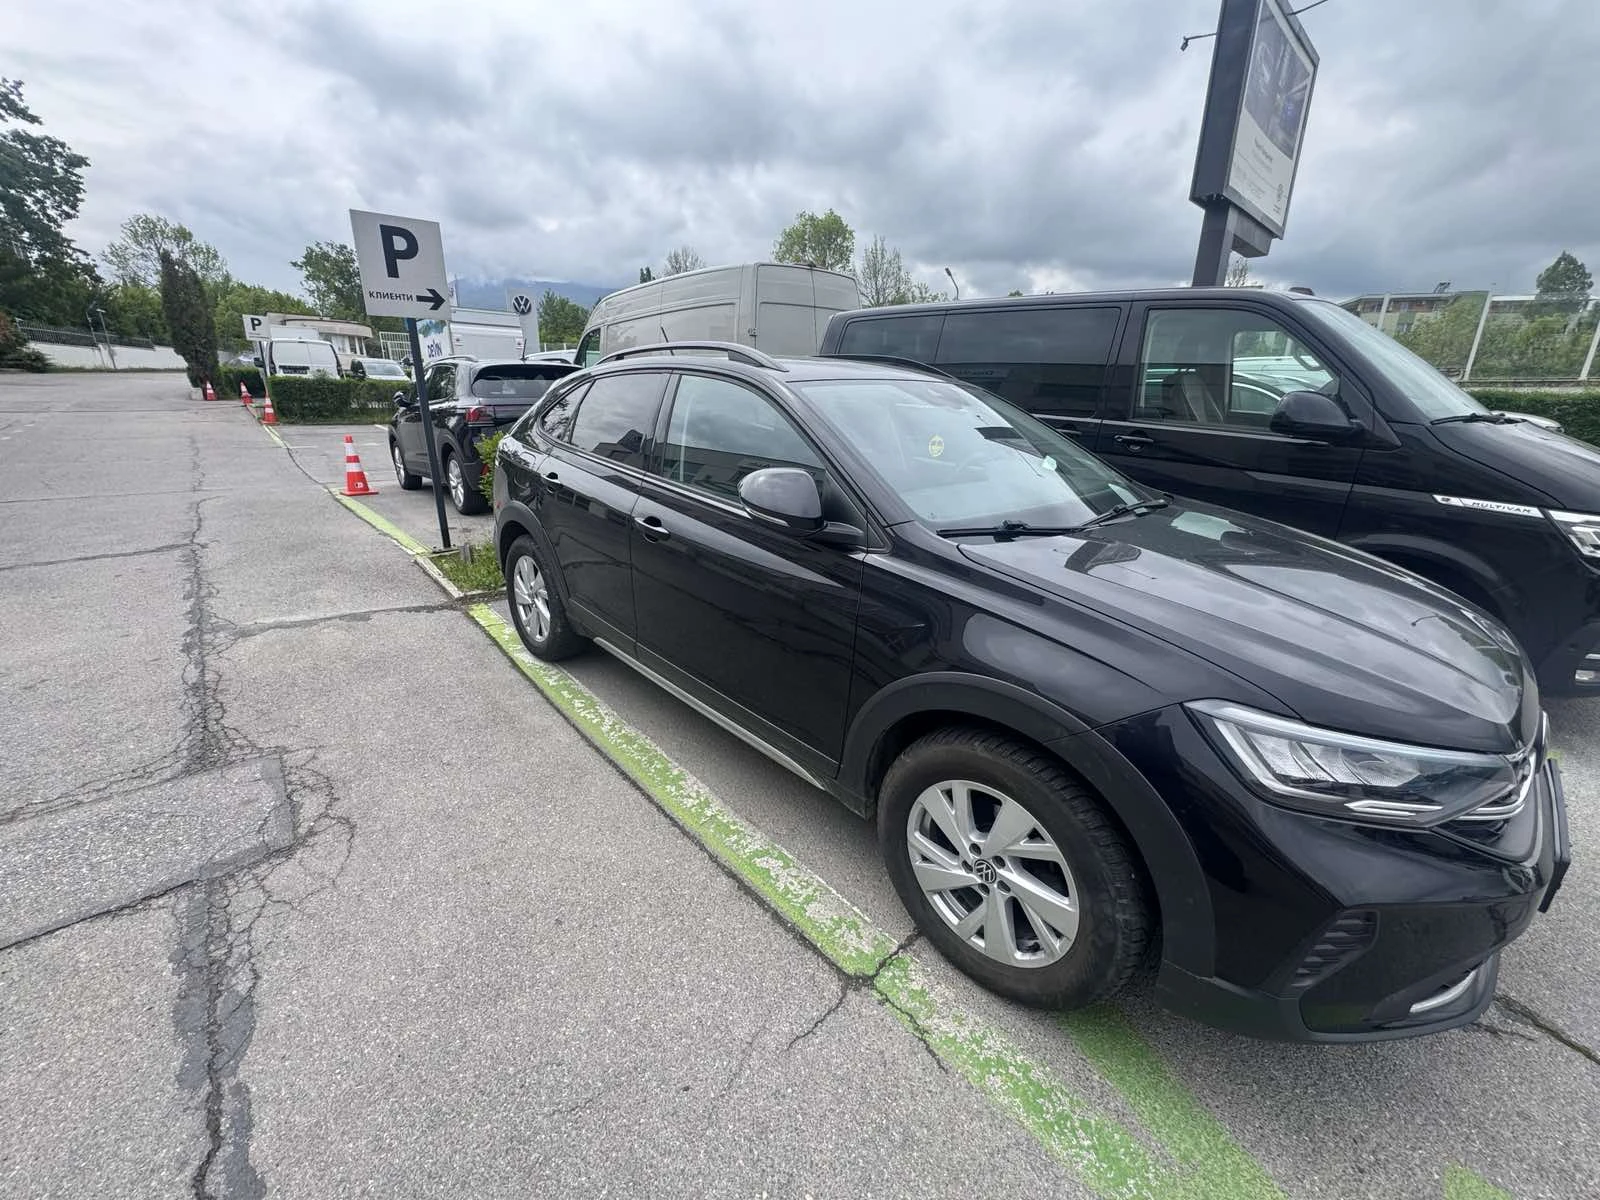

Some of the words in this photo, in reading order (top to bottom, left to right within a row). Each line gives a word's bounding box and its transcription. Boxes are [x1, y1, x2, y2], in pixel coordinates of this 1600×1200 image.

[379, 224, 419, 278] P
[369, 291, 414, 302] КЛИЕНТИ
[250, 317, 262, 331] P
[1471, 502, 1531, 513] MULTIVAN
